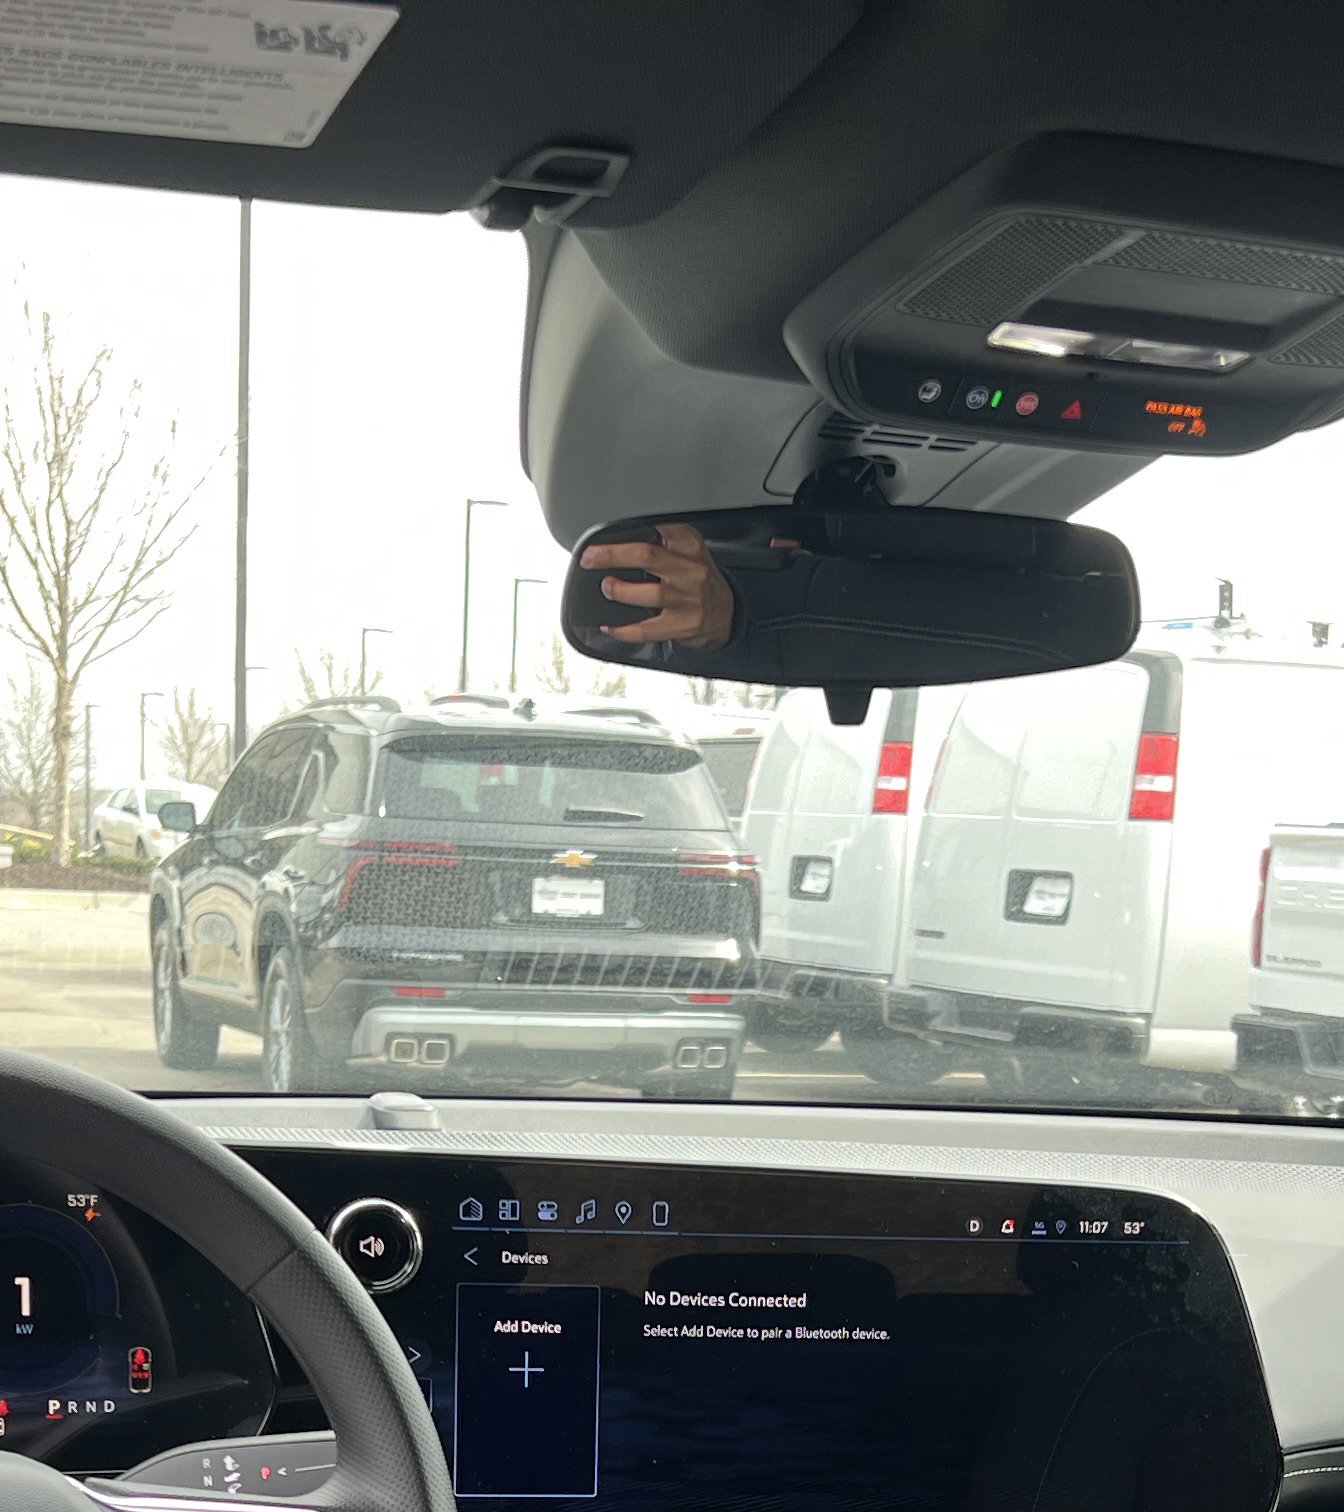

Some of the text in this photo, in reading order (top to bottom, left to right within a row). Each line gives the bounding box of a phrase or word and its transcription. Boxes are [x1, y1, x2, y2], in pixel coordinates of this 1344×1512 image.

[67, 1193, 98, 1207] 53°F
[969, 1219, 980, 1233] D
[1079, 1220, 1109, 1234] 11:07
[1123, 1221, 1145, 1235] 53°
[501, 1250, 549, 1265] Devices
[15, 1277, 30, 1317] 1
[643, 1291, 807, 1309] No Devices Connected
[16, 1322, 34, 1335] kW
[493, 1320, 562, 1334] Add Device
[643, 1325, 891, 1342] Select Add Device to pair a Bluetooth device.
[48, 1400, 116, 1415] P R N D
